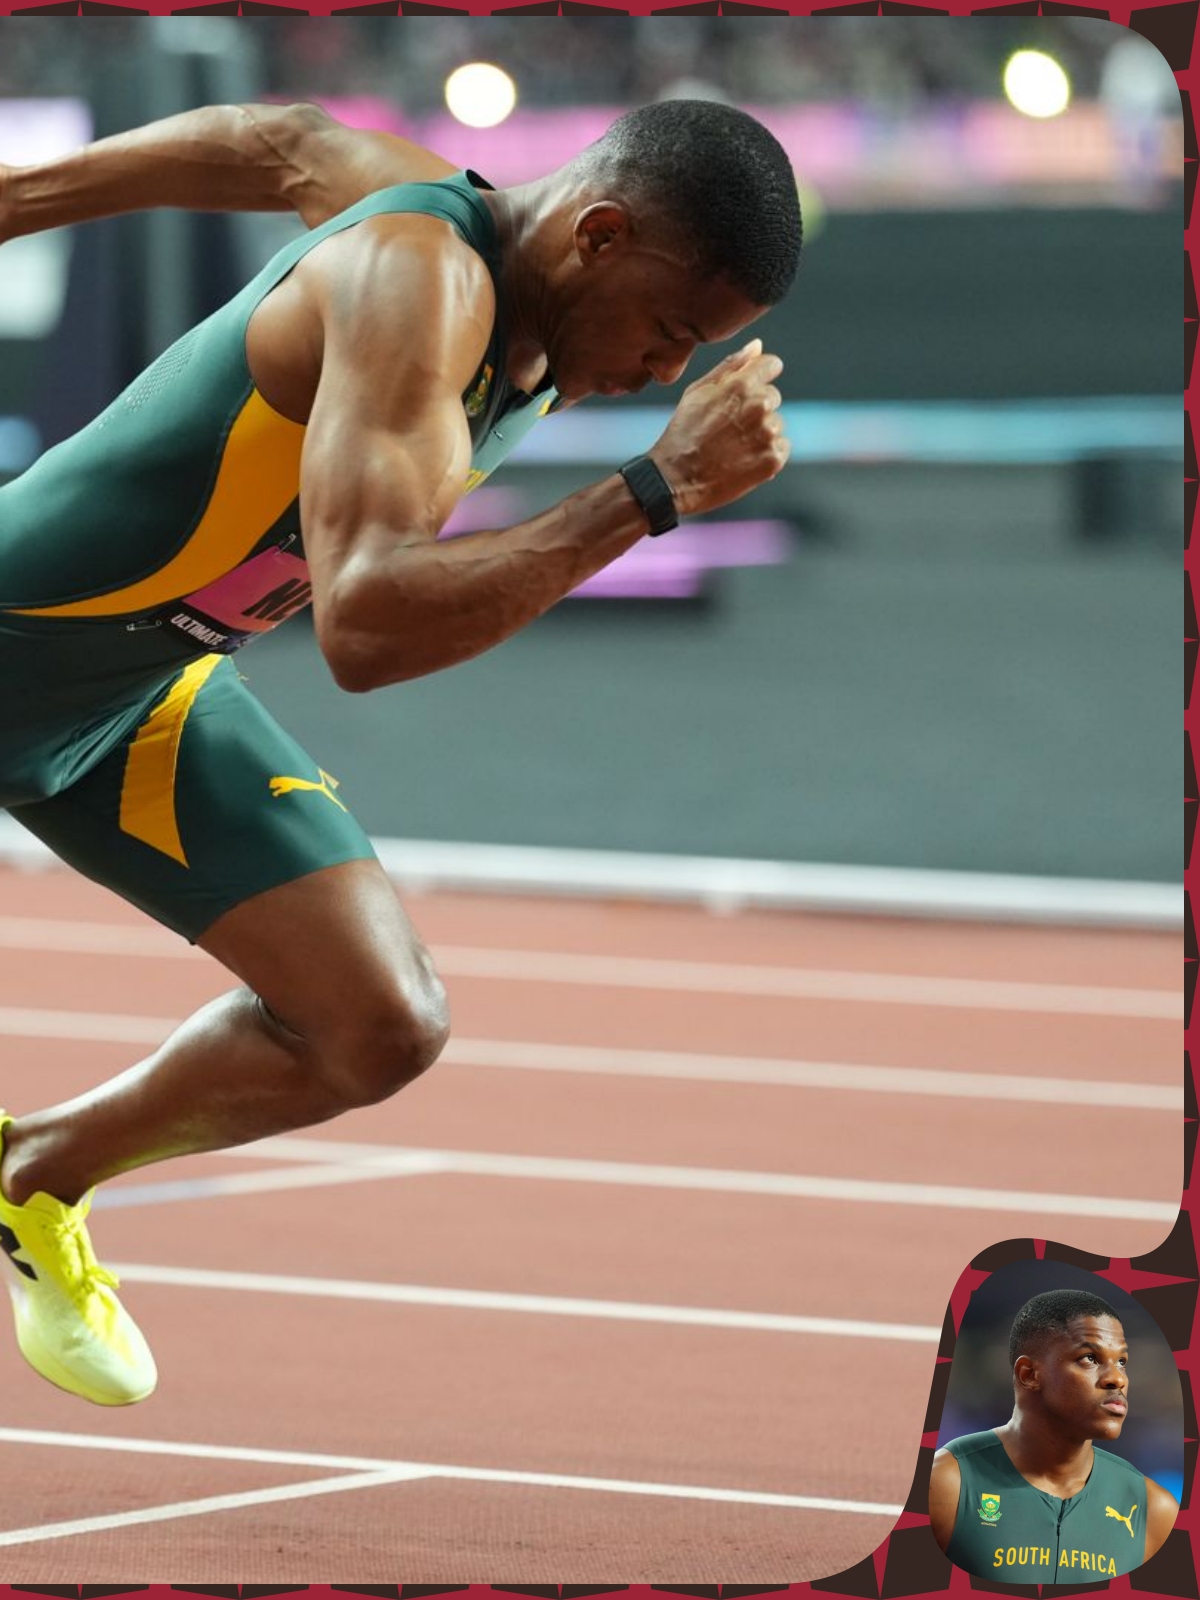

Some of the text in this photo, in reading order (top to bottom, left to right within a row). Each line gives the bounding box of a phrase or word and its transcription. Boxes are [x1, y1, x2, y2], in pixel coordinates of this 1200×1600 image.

[170, 613, 228, 646] ULTIMATE
[993, 1546, 1117, 1577] SOUTH AFRICA
